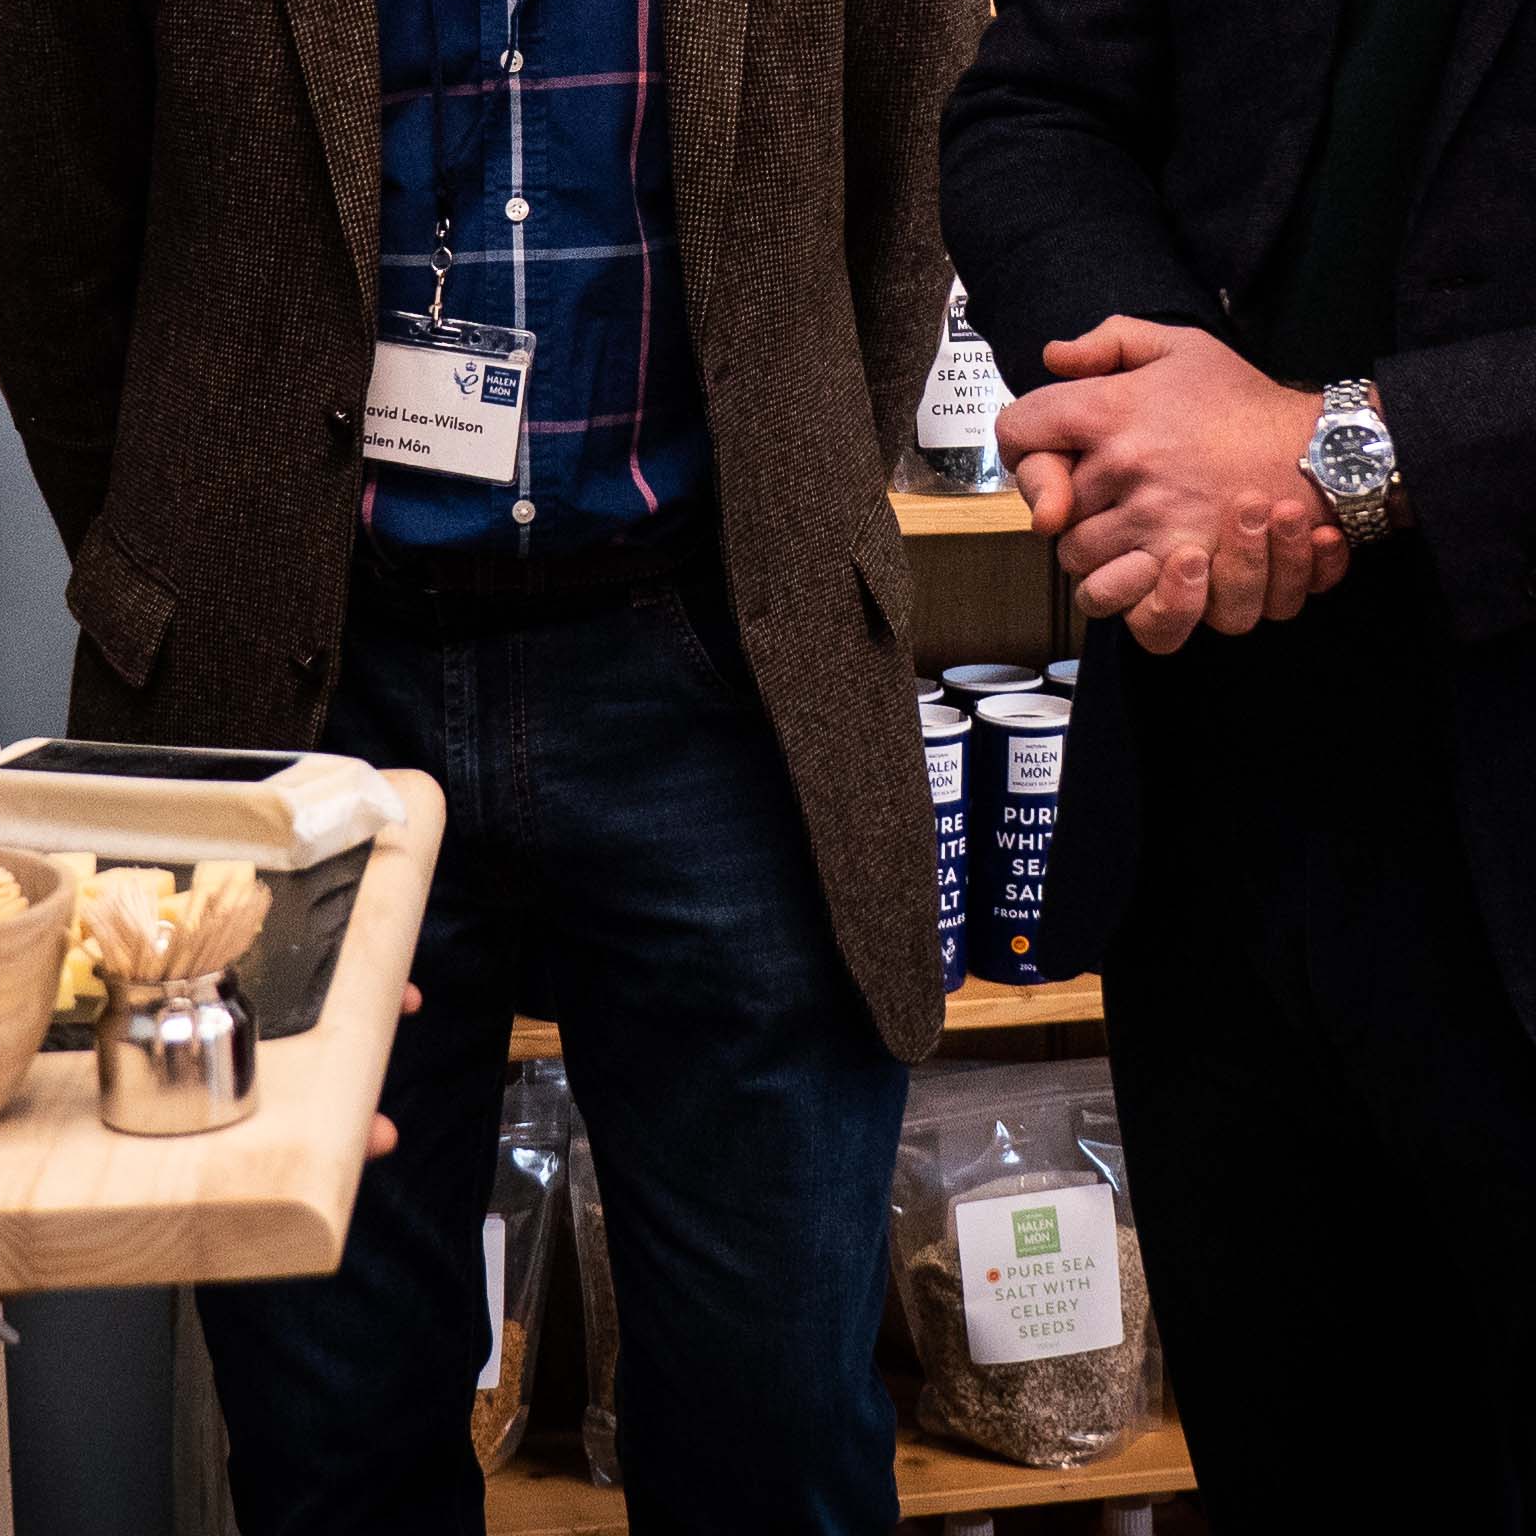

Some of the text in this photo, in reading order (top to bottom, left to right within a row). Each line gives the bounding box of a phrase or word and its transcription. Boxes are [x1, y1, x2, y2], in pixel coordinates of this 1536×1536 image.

[954, 352, 993, 363] PURE
[486, 374, 516, 387] HALEN
[938, 367, 1001, 381] SEA SAL
[954, 386, 994, 398] WITH
[932, 403, 1013, 416] CHARCOA
[365, 406, 483, 434] avid Lea-Wilson
[364, 433, 430, 454] alen Môn
[1014, 751, 1058, 763] HALEN
[1020, 765, 1052, 778] MÔN
[994, 907, 1028, 919] FROM
[1017, 1219, 1054, 1232] HALEN
[1007, 1256, 1095, 1278] PURE SEA
[995, 1278, 1090, 1301] SALT WITH
[1011, 1298, 1078, 1319] CELERY
[1019, 1319, 1075, 1338] SEEDS
